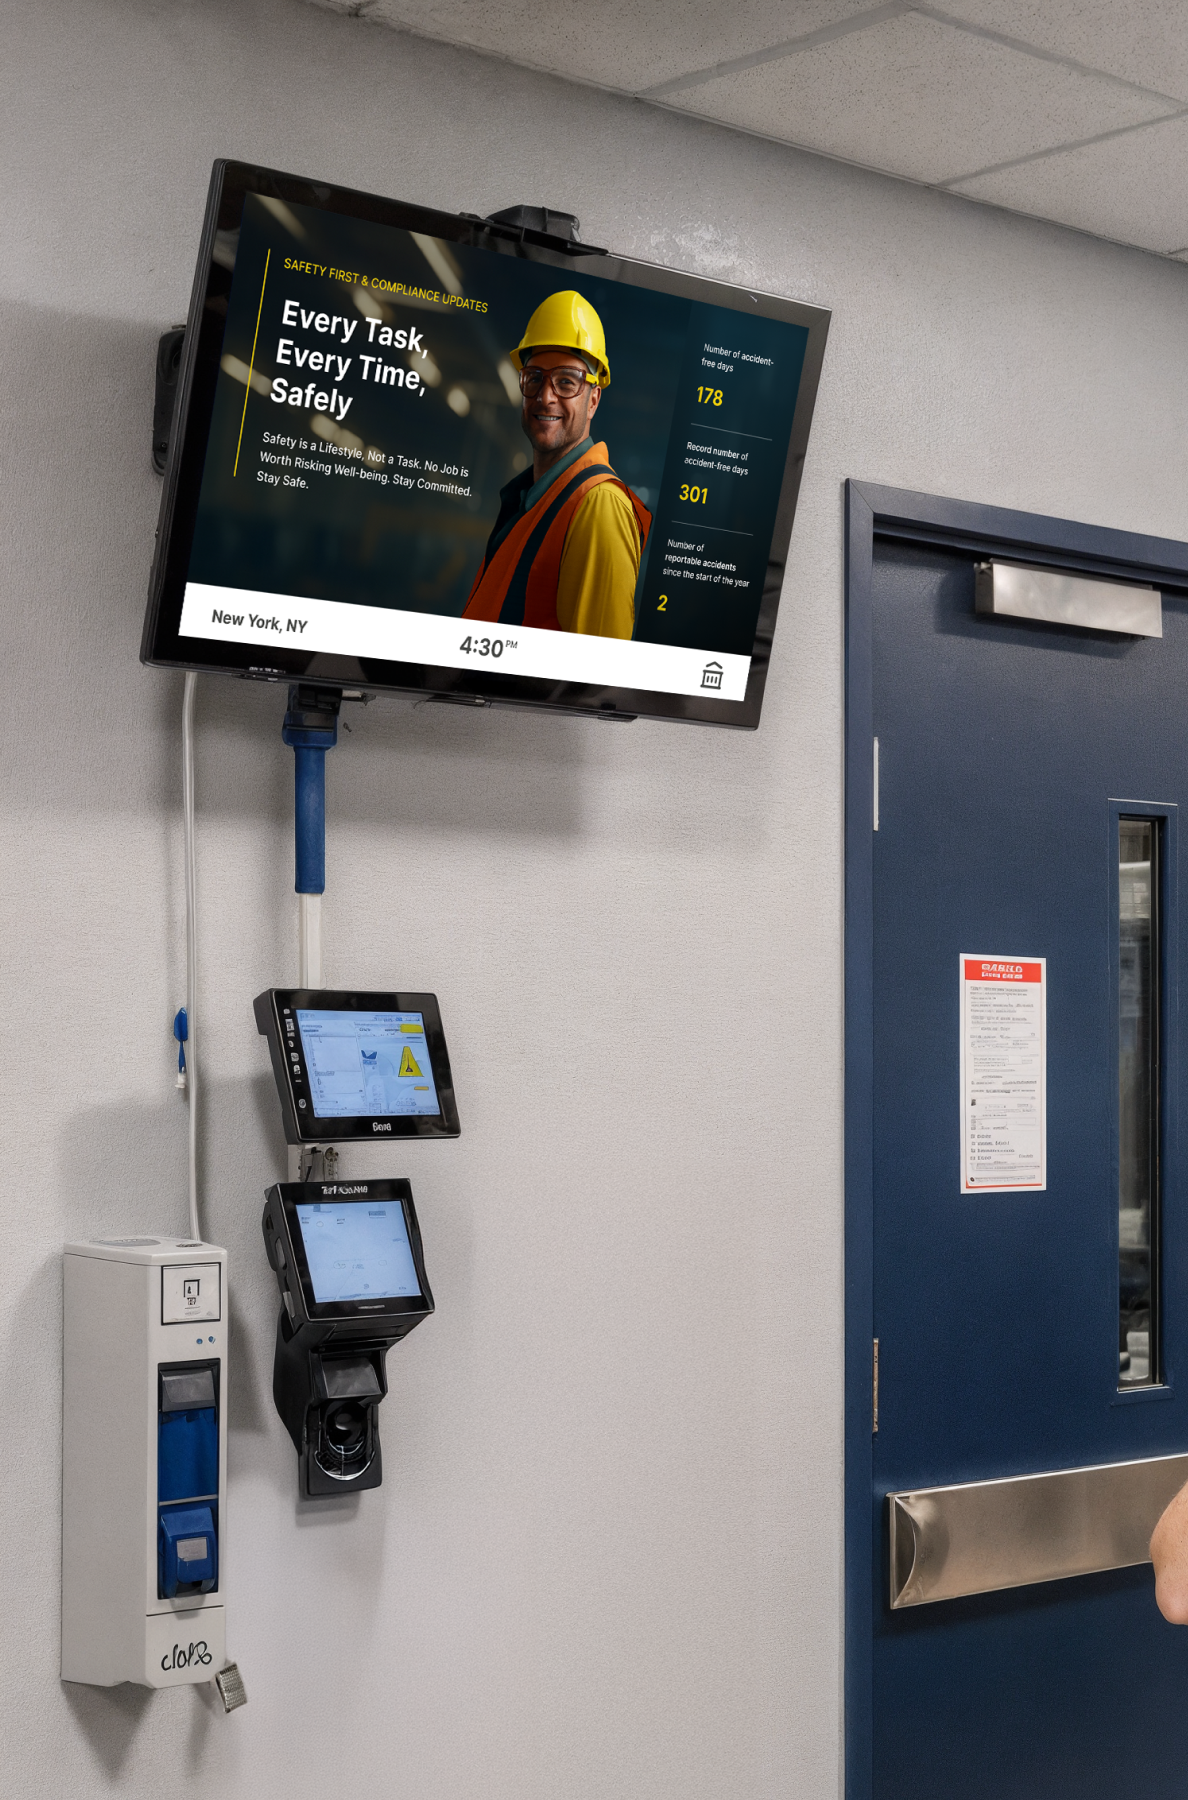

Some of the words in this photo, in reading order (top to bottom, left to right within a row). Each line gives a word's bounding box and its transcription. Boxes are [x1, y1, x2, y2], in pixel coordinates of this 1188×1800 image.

[284, 257, 327, 277] SAFETY
[328, 267, 360, 285] FIRST
[361, 275, 369, 287] &
[371, 278, 440, 303] COMPLIANCE
[442, 294, 489, 313] UPDATES
[282, 299, 358, 344] Every
[365, 316, 428, 359] Task,
[701, 357, 716, 368] free
[717, 361, 734, 373] days
[703, 343, 732, 357] Number
[732, 350, 741, 359] of
[741, 353, 774, 366] accident-
[276, 338, 352, 382] Every
[359, 354, 426, 397] Time,
[270, 377, 353, 421] Safely
[697, 385, 724, 407] 178
[262, 431, 297, 449] Safety
[299, 438, 308, 449] is
[310, 442, 317, 451] a
[319, 441, 365, 461] Lifestyle,
[367, 450, 386, 463] Not
[388, 455, 394, 465] a
[397, 455, 422, 470] Task.
[424, 460, 439, 472] No
[440, 463, 459, 476] Job
[460, 466, 469, 477] is
[686, 441, 713, 454] Record
[712, 448, 740, 459] number
[740, 452, 749, 461] of
[260, 450, 292, 466] Worth
[294, 457, 332, 476] Risking
[334, 463, 390, 485] Well-being.
[392, 473, 415, 489] Stay
[417, 478, 472, 497] Committed.
[684, 457, 731, 472] accident-free
[731, 465, 749, 476] days
[256, 470, 280, 486] Stay
[282, 474, 309, 489] Safe.
[679, 483, 708, 504] 301
[667, 538, 696, 551] Number
[696, 543, 705, 552] of
[664, 553, 702, 566] reportable
[702, 560, 737, 572] accidents
[662, 566, 682, 577] since
[682, 570, 695, 579] the
[695, 572, 712, 582] start
[713, 575, 722, 583] of
[722, 576, 734, 585] the
[734, 579, 750, 588] year
[657, 594, 668, 612] 2
[211, 609, 245, 626] New
[248, 613, 283, 634] York,
[286, 618, 309, 634] NY
[459, 635, 504, 658] 4:30
